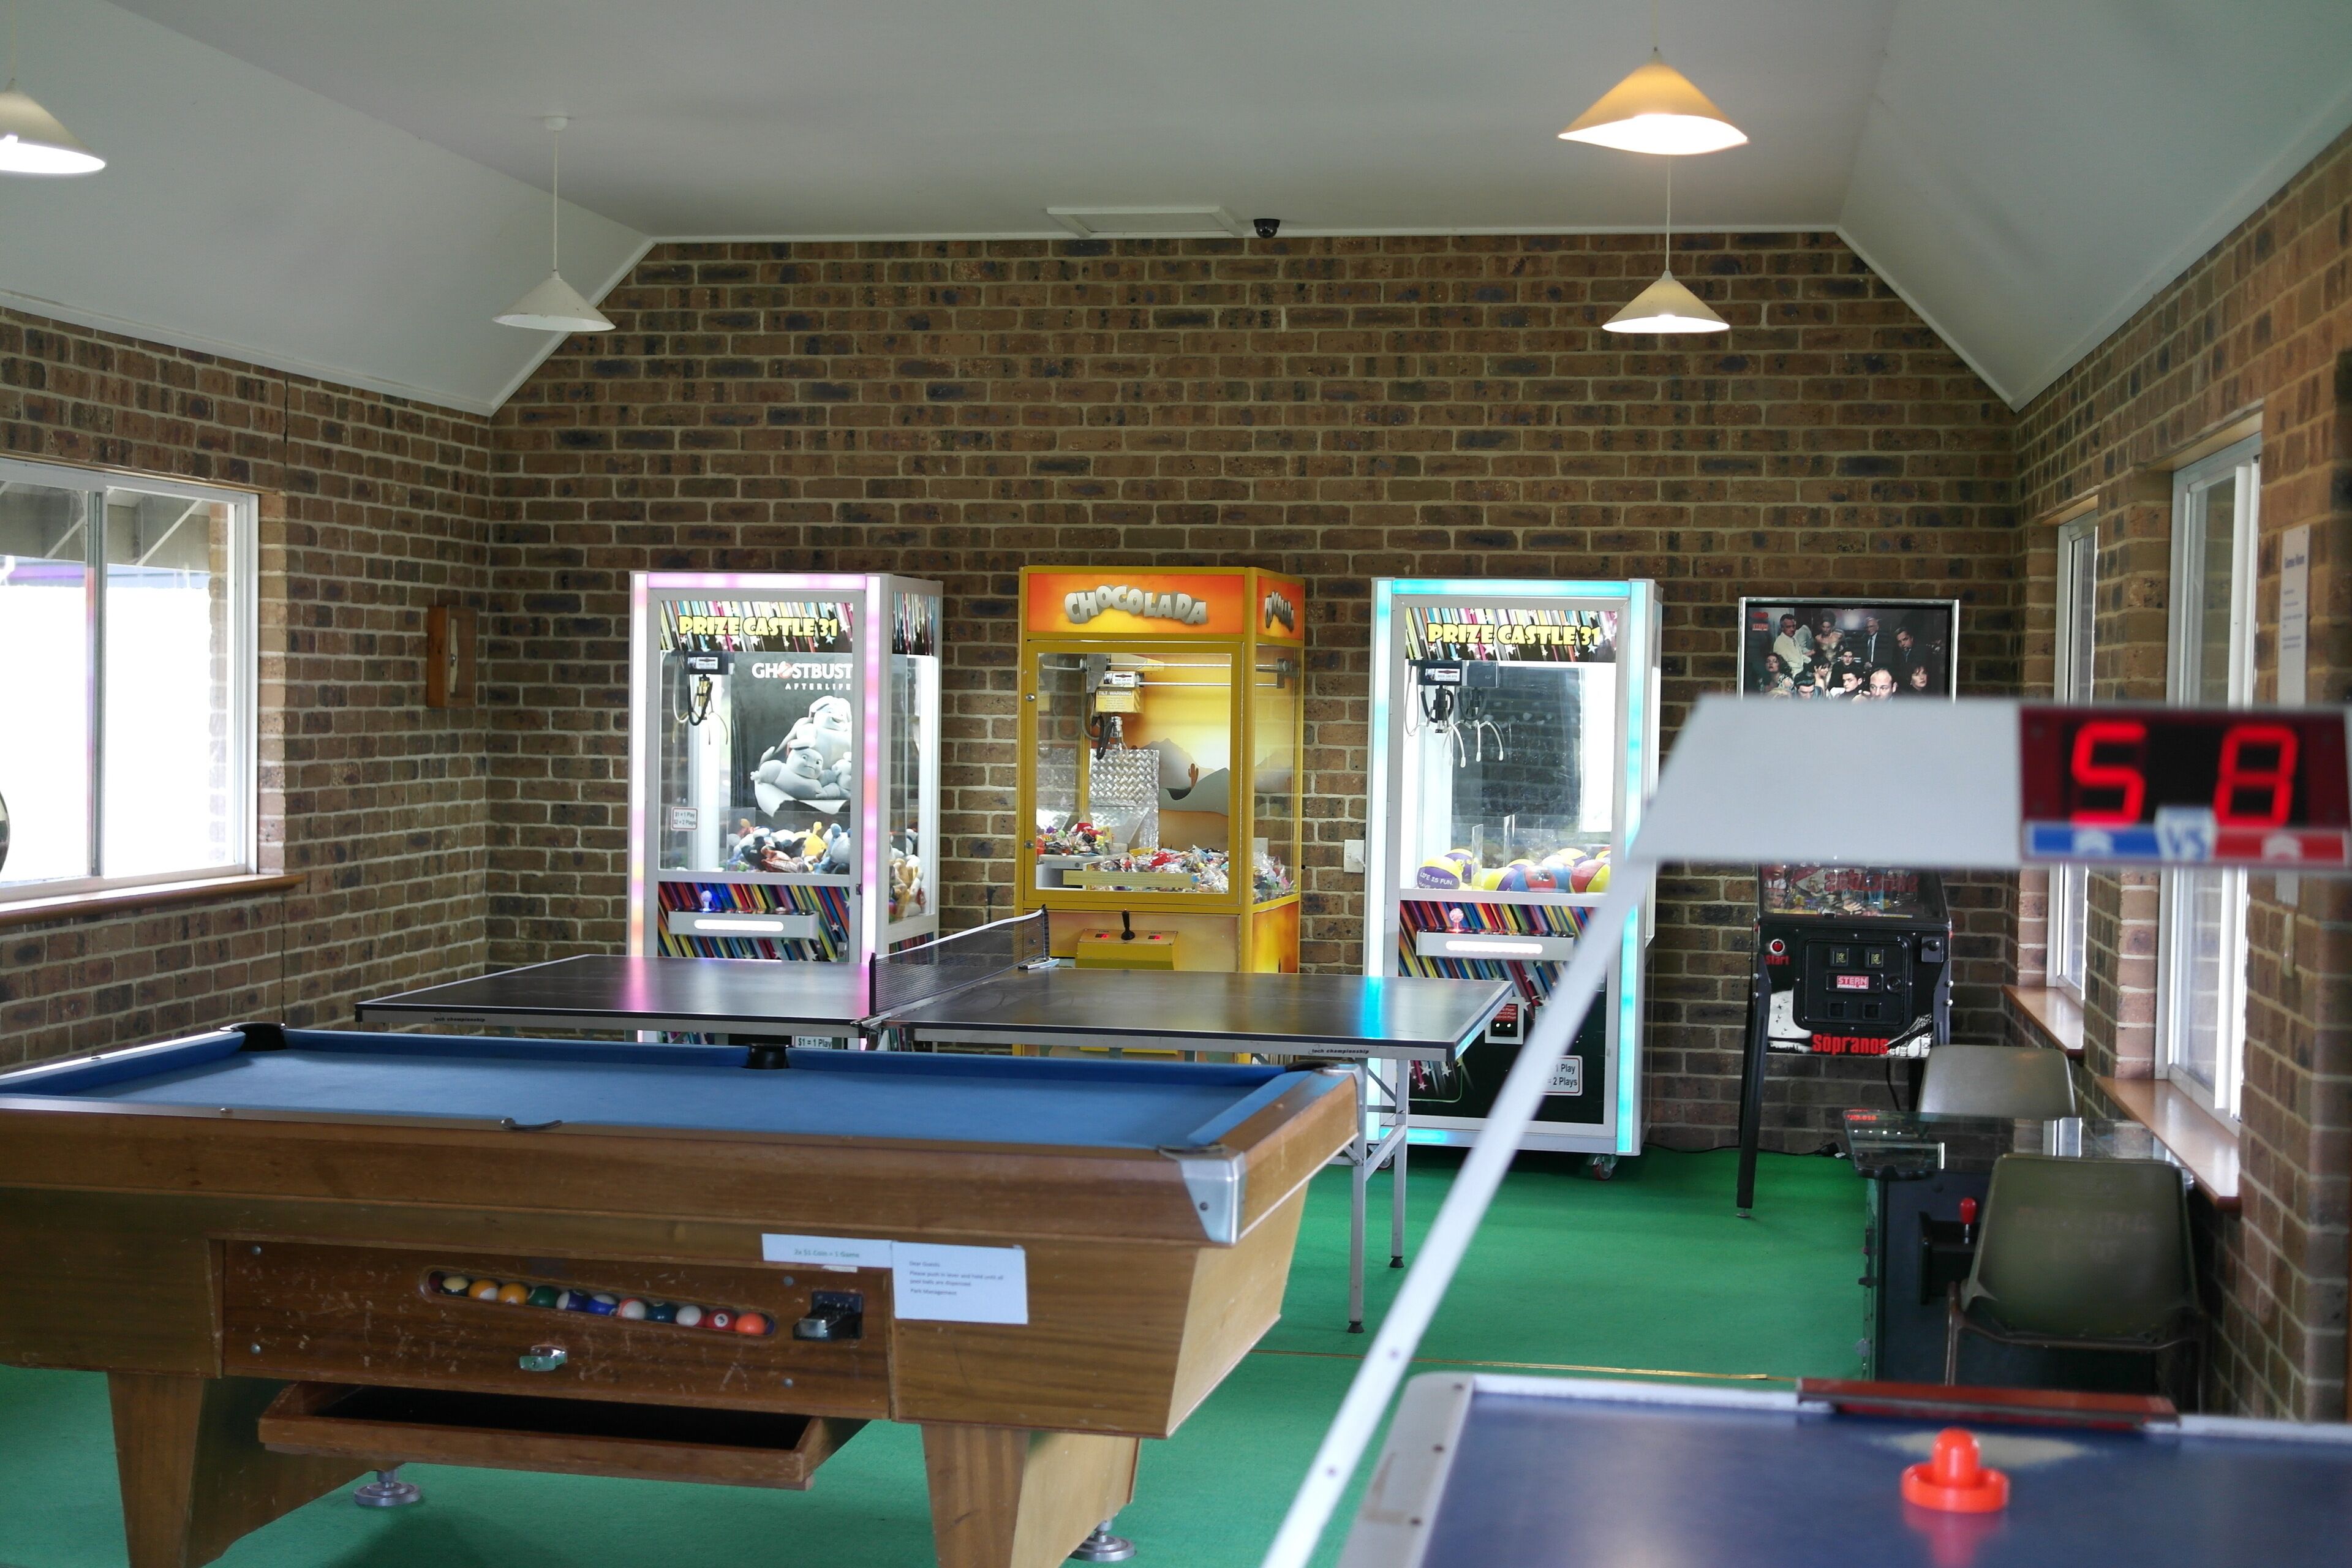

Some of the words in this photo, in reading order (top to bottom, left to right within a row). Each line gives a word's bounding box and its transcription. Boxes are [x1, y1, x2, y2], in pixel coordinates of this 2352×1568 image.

[1064, 585, 1208, 624] CHOCOLADA
[679, 616, 740, 636] PRIZE
[742, 617, 816, 637] CASTLE
[819, 619, 839, 637] 31
[1427, 623, 1495, 644] PRIZE
[1497, 624, 1577, 646] CASTLE
[1580, 625, 1601, 646] 31
[2070, 720, 2148, 830] 5
[2214, 723, 2299, 830] 8
[1420, 872, 1431, 881] LIFE
[1838, 976, 1867, 985] STERN
[798, 1037, 805, 1046] $1
[813, 1038, 816, 1047] 1
[818, 1039, 832, 1049] Play
[1812, 1033, 1890, 1055] Sopranos
[1561, 1063, 1575, 1074] Play
[1553, 1077, 1558, 1085] 2
[1559, 1077, 1578, 1088] Plays
